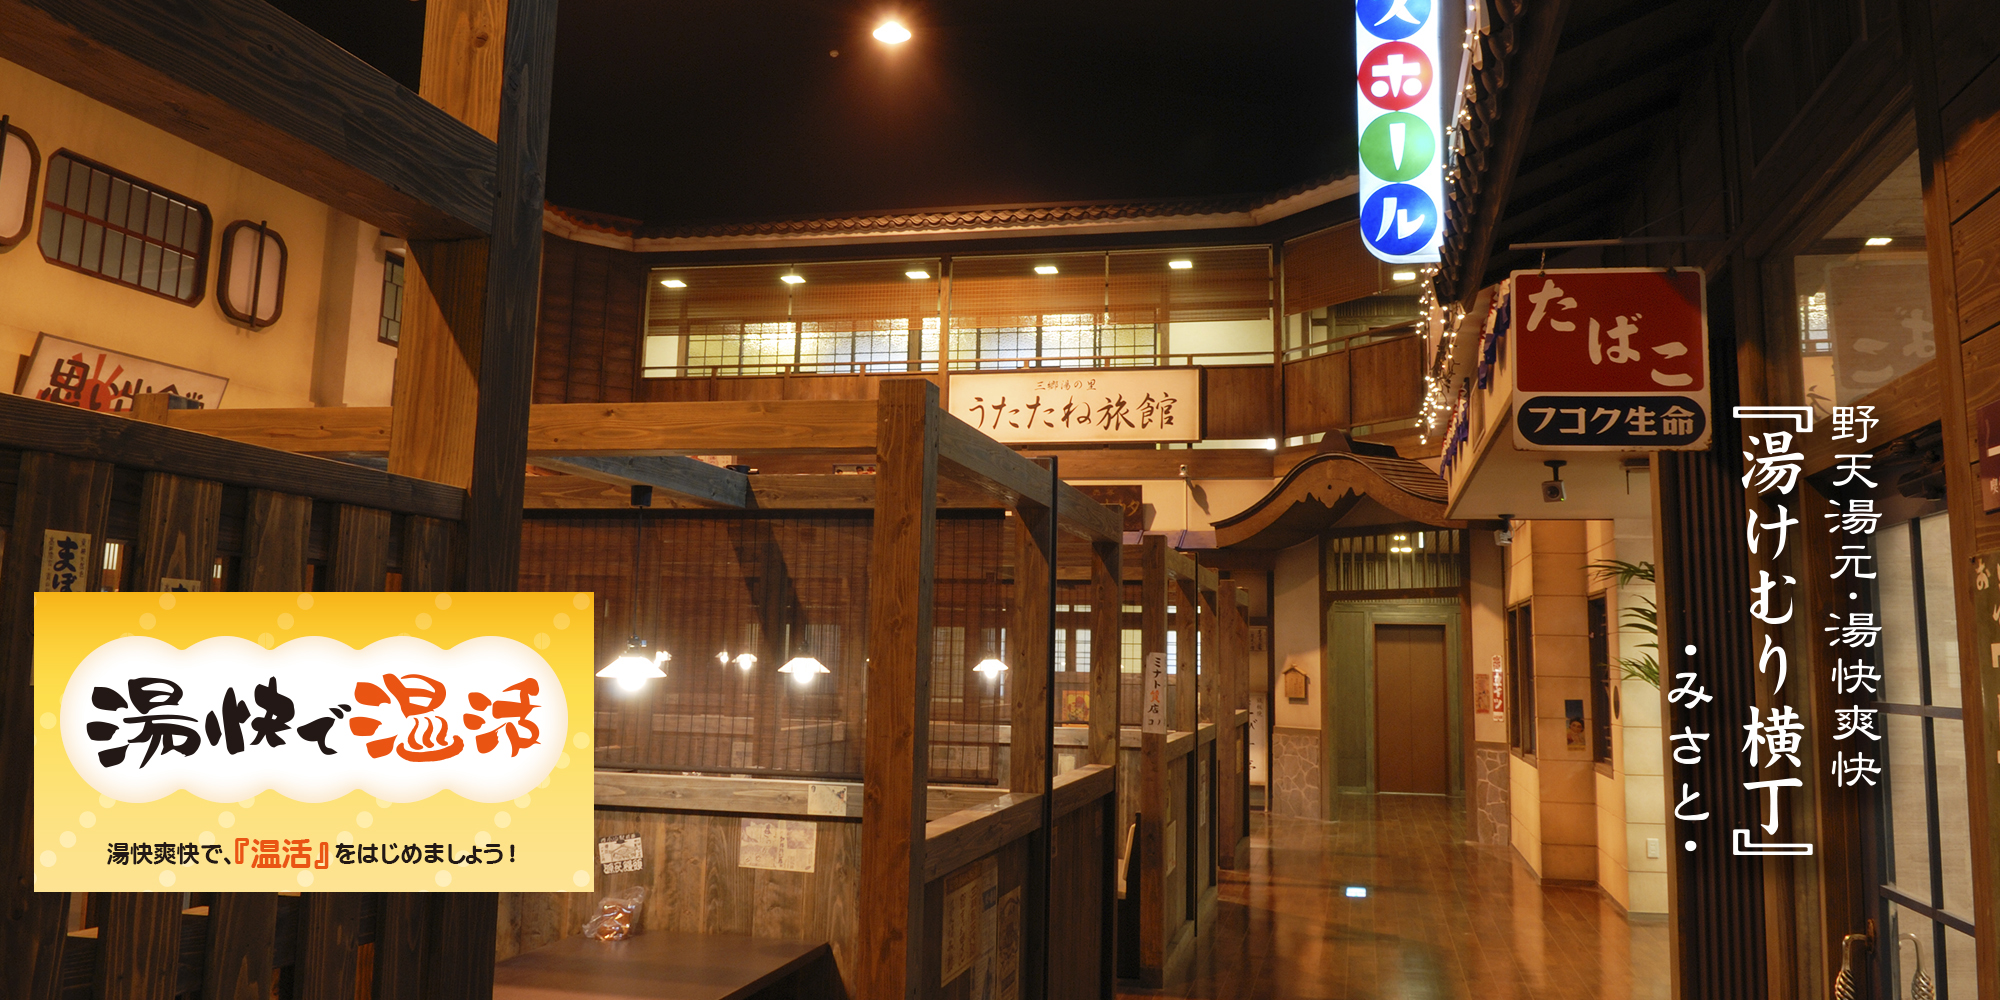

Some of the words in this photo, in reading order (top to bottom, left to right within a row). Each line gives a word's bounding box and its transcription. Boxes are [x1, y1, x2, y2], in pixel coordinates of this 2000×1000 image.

[1526, 279, 1693, 387] たばこ
[1034, 378, 1097, 391] 三郷湯の里
[969, 392, 1177, 431] うたたね旅館
[1528, 405, 1696, 436] フコク生命
